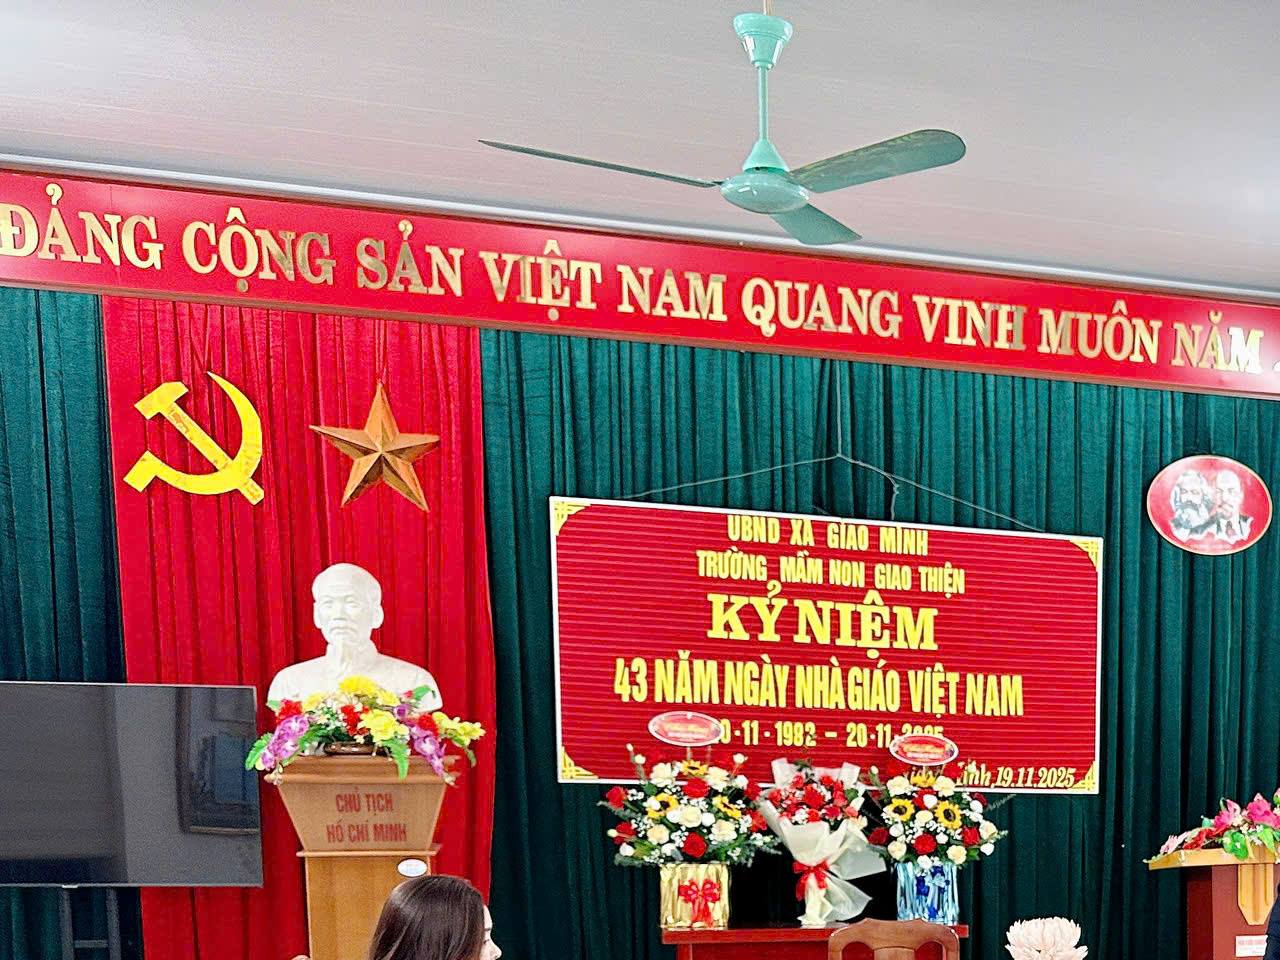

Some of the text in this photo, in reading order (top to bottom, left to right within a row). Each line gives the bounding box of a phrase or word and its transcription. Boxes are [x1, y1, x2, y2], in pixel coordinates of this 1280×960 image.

[0, 183, 1264, 374] ĐẢNG CỘNG SẢN VIỆT NAM QUANG VINH MUÔN NĂM
[727, 514, 780, 544] UBND
[826, 519, 869, 551] GIAO
[879, 524, 929, 556] MINH
[696, 546, 966, 599] TRƯỜNG MẦM NON GIAO THIỆN
[706, 579, 938, 660] KỶ NIỆM
[614, 650, 1024, 719] 43 NĂM NGÀY NHÀ GIÁO VIỆT NAM
[373, 823, 408, 842] MINH
